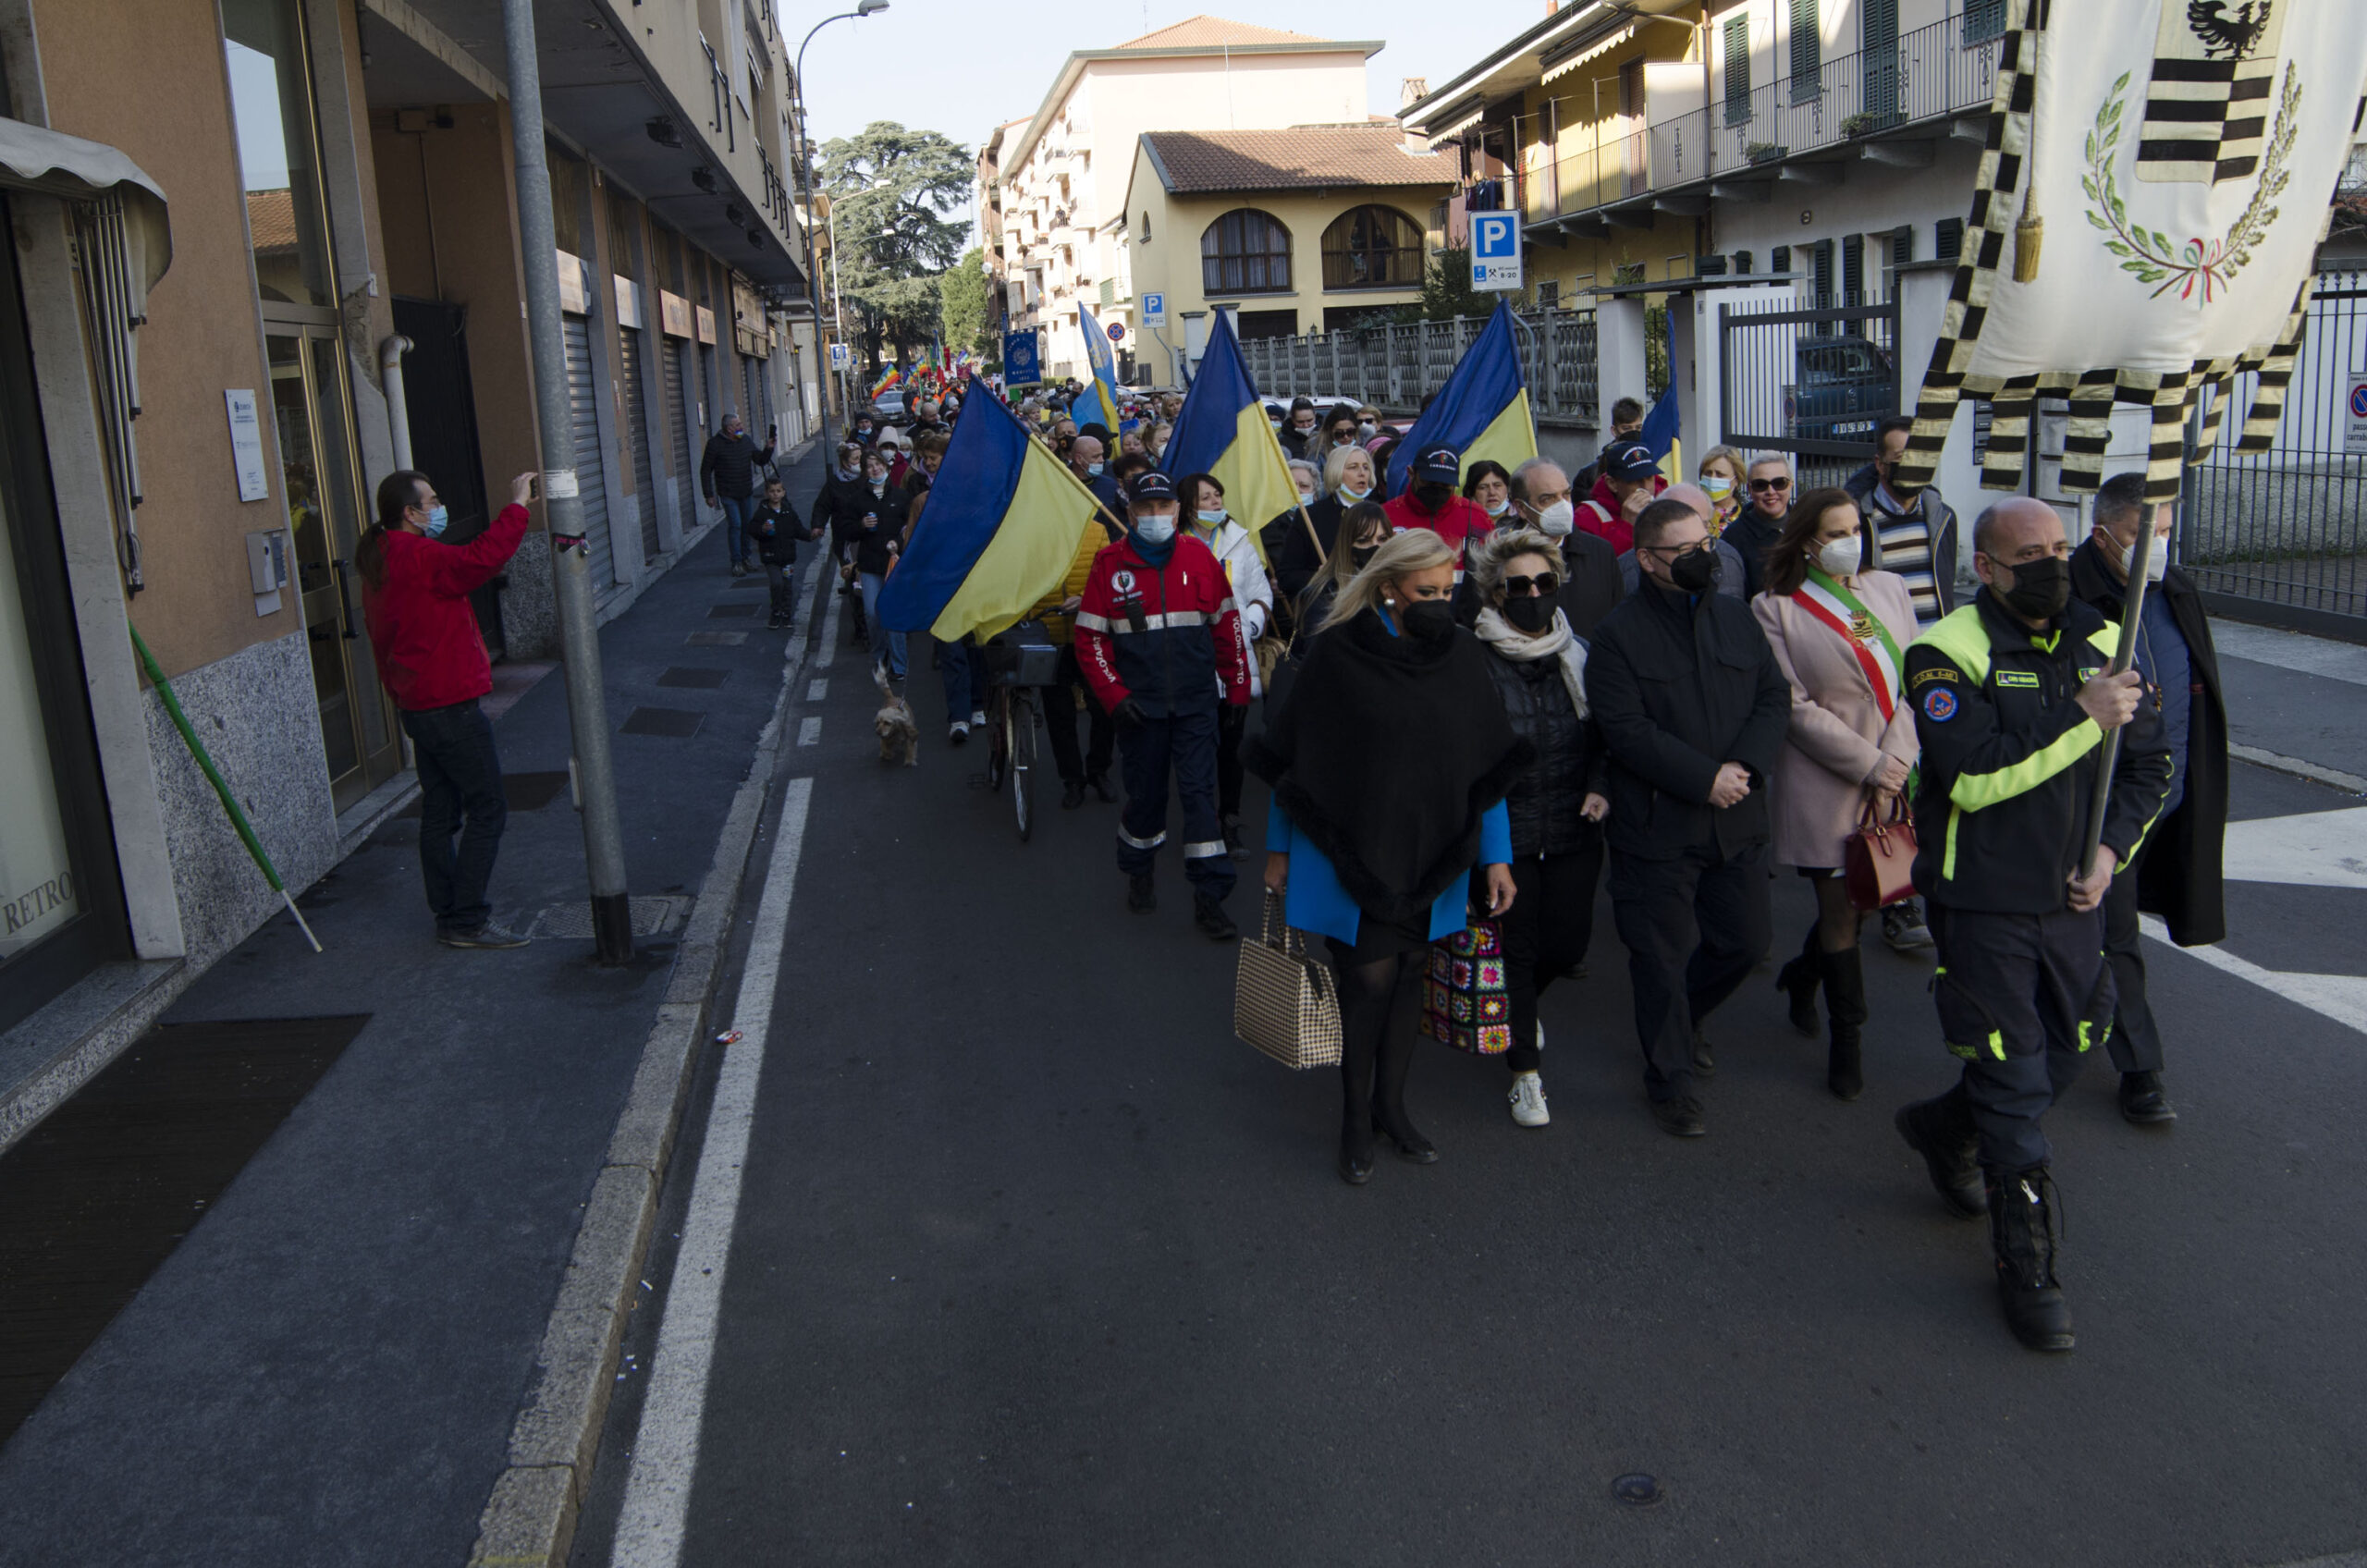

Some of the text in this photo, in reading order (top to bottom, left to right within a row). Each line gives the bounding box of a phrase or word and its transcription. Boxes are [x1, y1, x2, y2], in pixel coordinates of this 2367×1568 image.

[1484, 220, 1506, 253] P
[1147, 297, 1159, 312] P
[3, 871, 73, 935] RETRO
